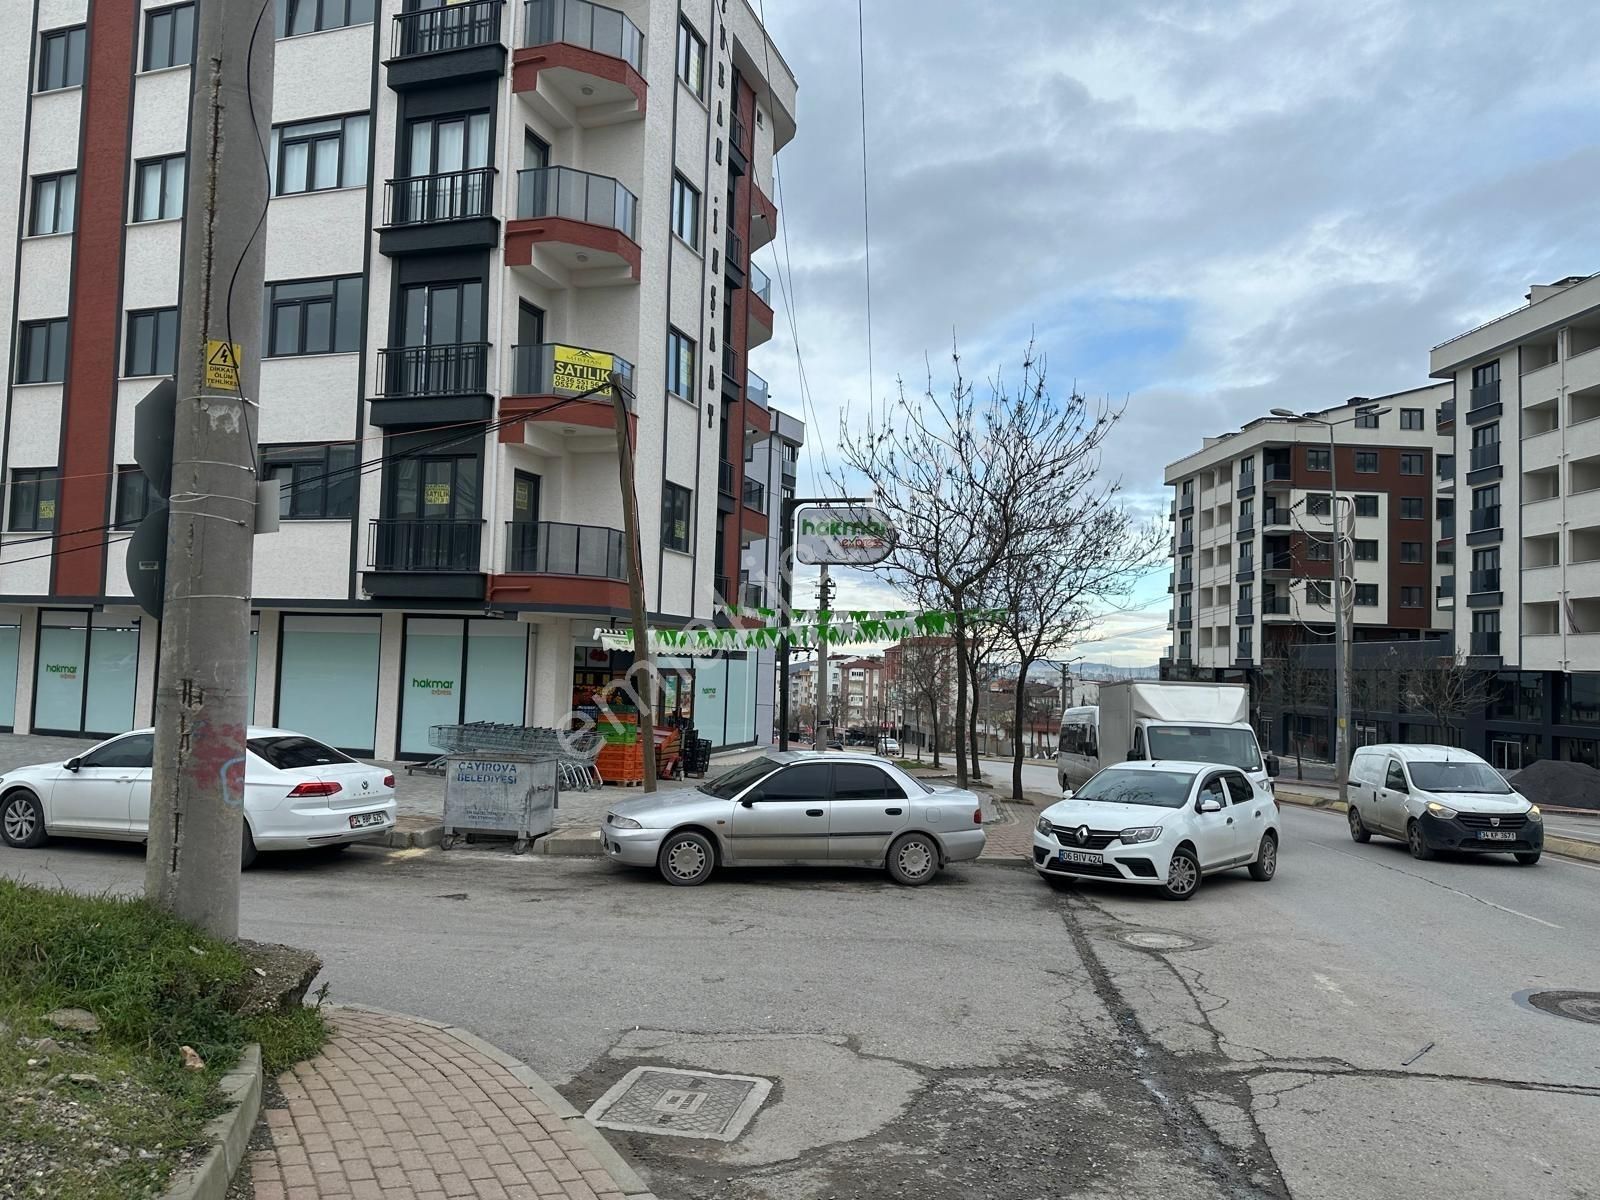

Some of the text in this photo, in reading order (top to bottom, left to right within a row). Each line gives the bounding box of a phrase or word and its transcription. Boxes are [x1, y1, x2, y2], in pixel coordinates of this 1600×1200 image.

[555, 362, 610, 382] SATILIK
[46, 664, 77, 673] hakmar
[412, 678, 454, 688] hakmar
[1063, 851, 1072, 860] 06
[1073, 853, 1086, 862] BIV
[1088, 855, 1102, 864] 424
